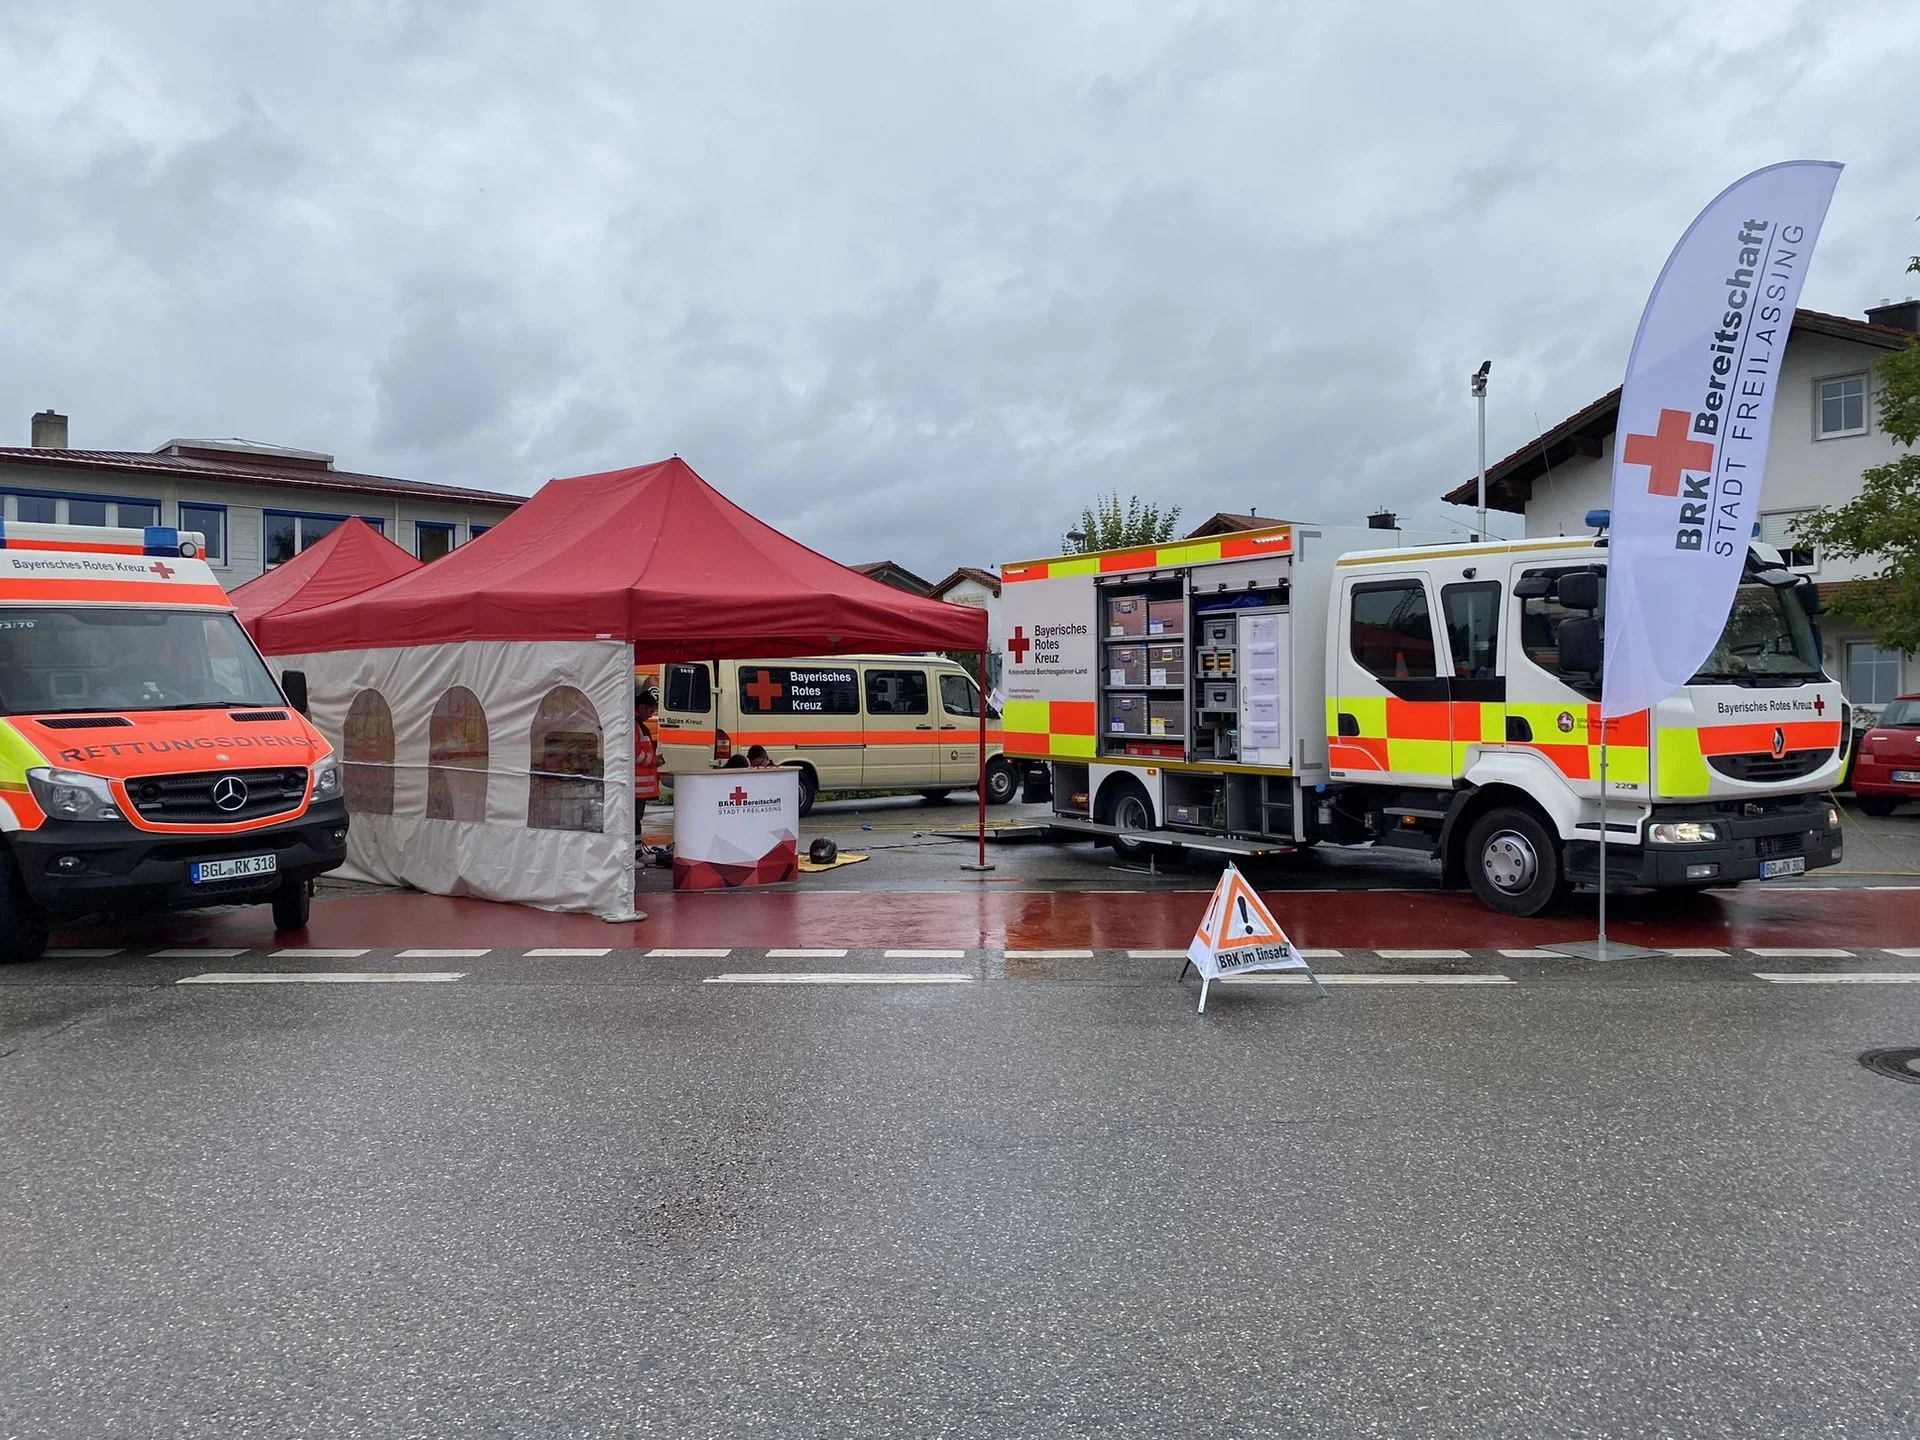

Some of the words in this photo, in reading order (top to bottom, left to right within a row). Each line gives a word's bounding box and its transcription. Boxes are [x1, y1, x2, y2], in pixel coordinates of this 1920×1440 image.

[1675, 474, 1711, 551] BRK
[1693, 218, 1769, 436] Bereitschaft
[1714, 457, 1747, 557] STADT
[1732, 224, 1804, 440] FREILASSING
[12, 559, 82, 571] Bayerisches
[82, 560, 114, 571] Rotes
[117, 562, 146, 573] Kreuz
[1034, 623, 1088, 639] Bayerisches
[1034, 639, 1060, 650] Rotes
[1034, 652, 1060, 664] Kreuz
[789, 671, 852, 684] Bayerisches
[791, 686, 821, 696] Rotes
[792, 700, 822, 710] Kreuz
[1717, 701, 1768, 716] Bayerisches
[1769, 700, 1791, 711] Rotes
[1792, 700, 1812, 711] Kreuz
[685, 718, 703, 726] Kreuz
[58, 736, 319, 763] RETTUNGSDIENST
[718, 800, 735, 808] BRK
[743, 797, 782, 806] Bereitschaft
[742, 806, 782, 814] FREILASSING
[201, 862, 227, 878] BGL
[235, 860, 251, 874] RK
[253, 856, 276, 871] 318
[1218, 952, 1241, 968] BRK
[1241, 951, 1255, 964] im
[1255, 945, 1289, 961] Einsatz
